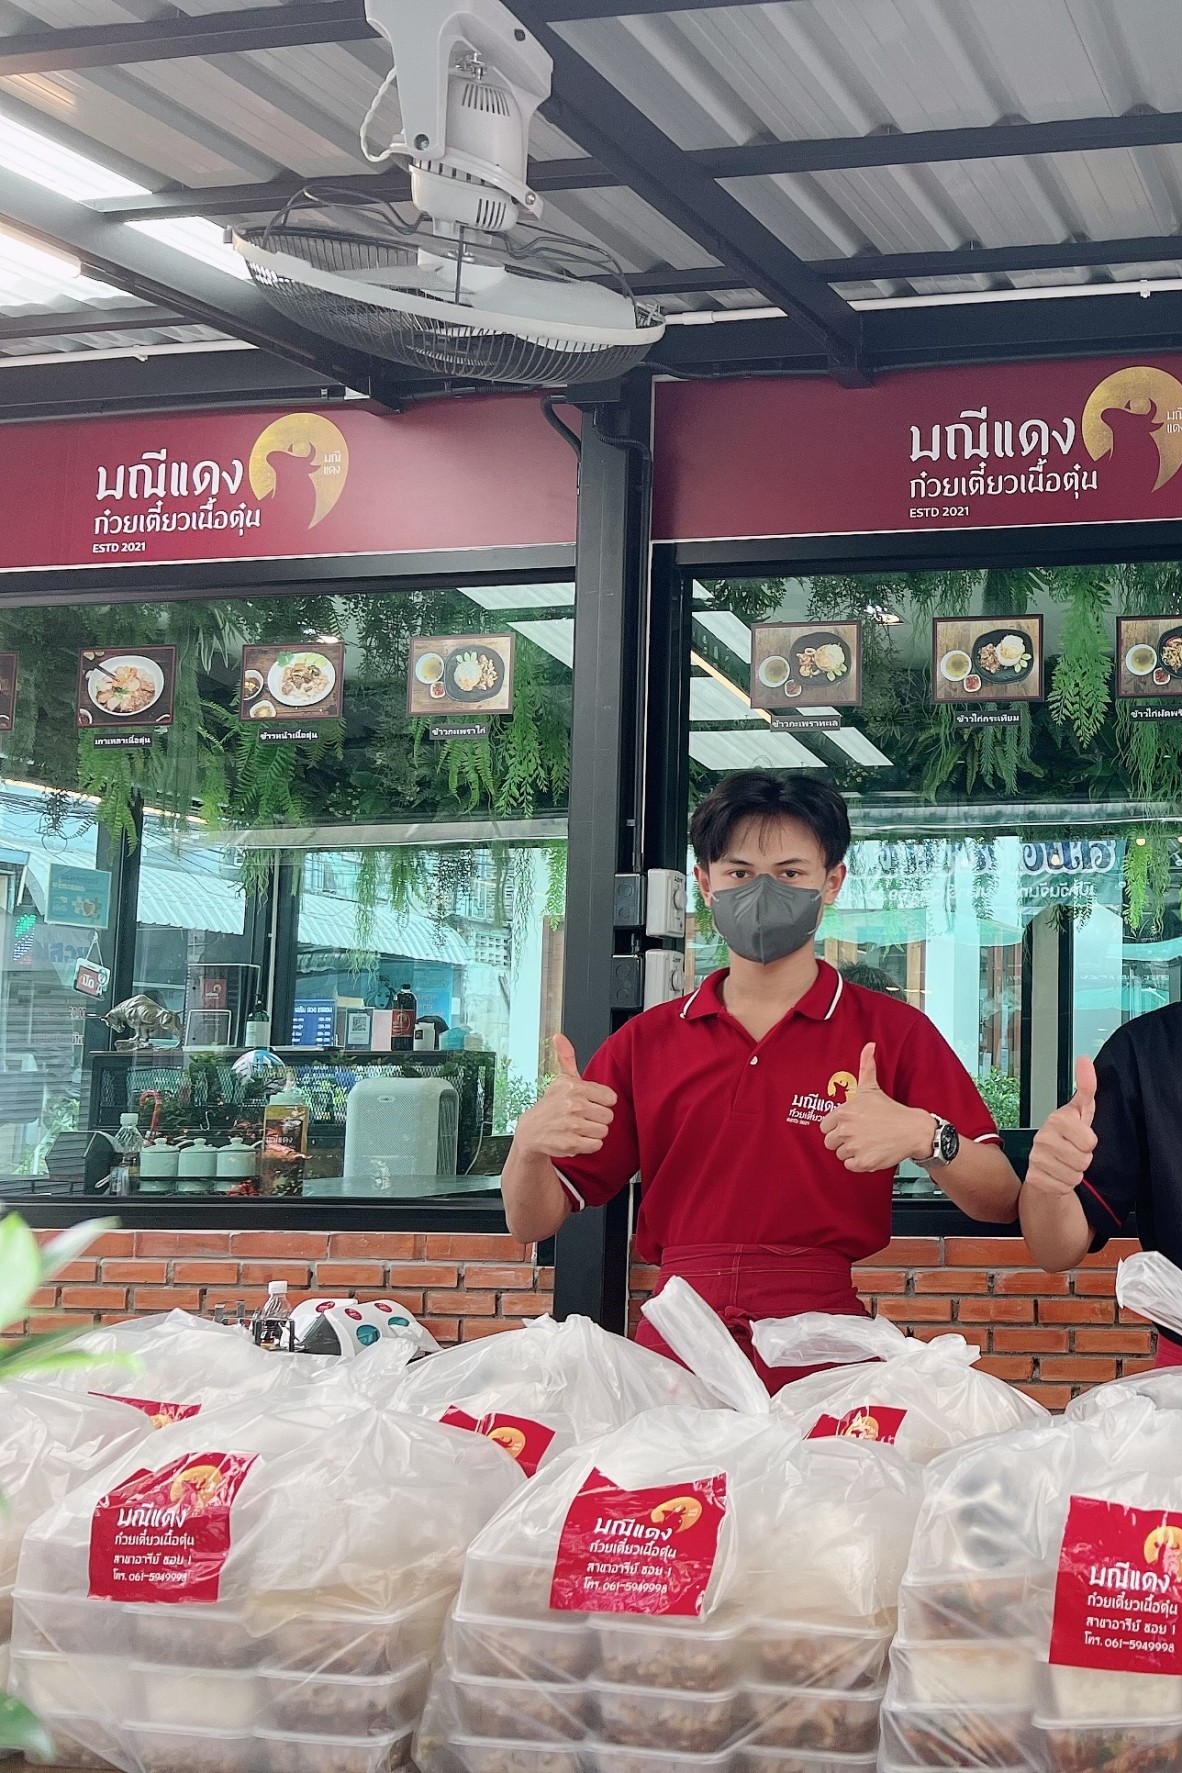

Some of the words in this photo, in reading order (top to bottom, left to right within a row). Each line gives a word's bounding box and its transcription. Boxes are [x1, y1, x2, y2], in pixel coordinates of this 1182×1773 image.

[908, 406, 1077, 463] มณีแดง
[95, 448, 244, 502] มณีแดง
[909, 458, 1099, 499] ก๋วยเตี๋ยวเนื้อตุ๋น
[93, 496, 262, 536] ก๋วยเตี๋ยวเนื้อตุ๋น
[909, 506, 940, 518] ESTD
[942, 504, 970, 517] 2021
[92, 542, 119, 553] ESTD
[121, 540, 146, 552] 2021
[117, 1502, 187, 1528] มณีแดง
[594, 1517, 672, 1541] มณีแดง
[1089, 1562, 1170, 1594] มณีแดง
[1087, 1592, 1178, 1618] ก๋วยเตี๋ยวเนื้อตุ๋น
[1104, 1637, 1175, 1653] 061-5949998
